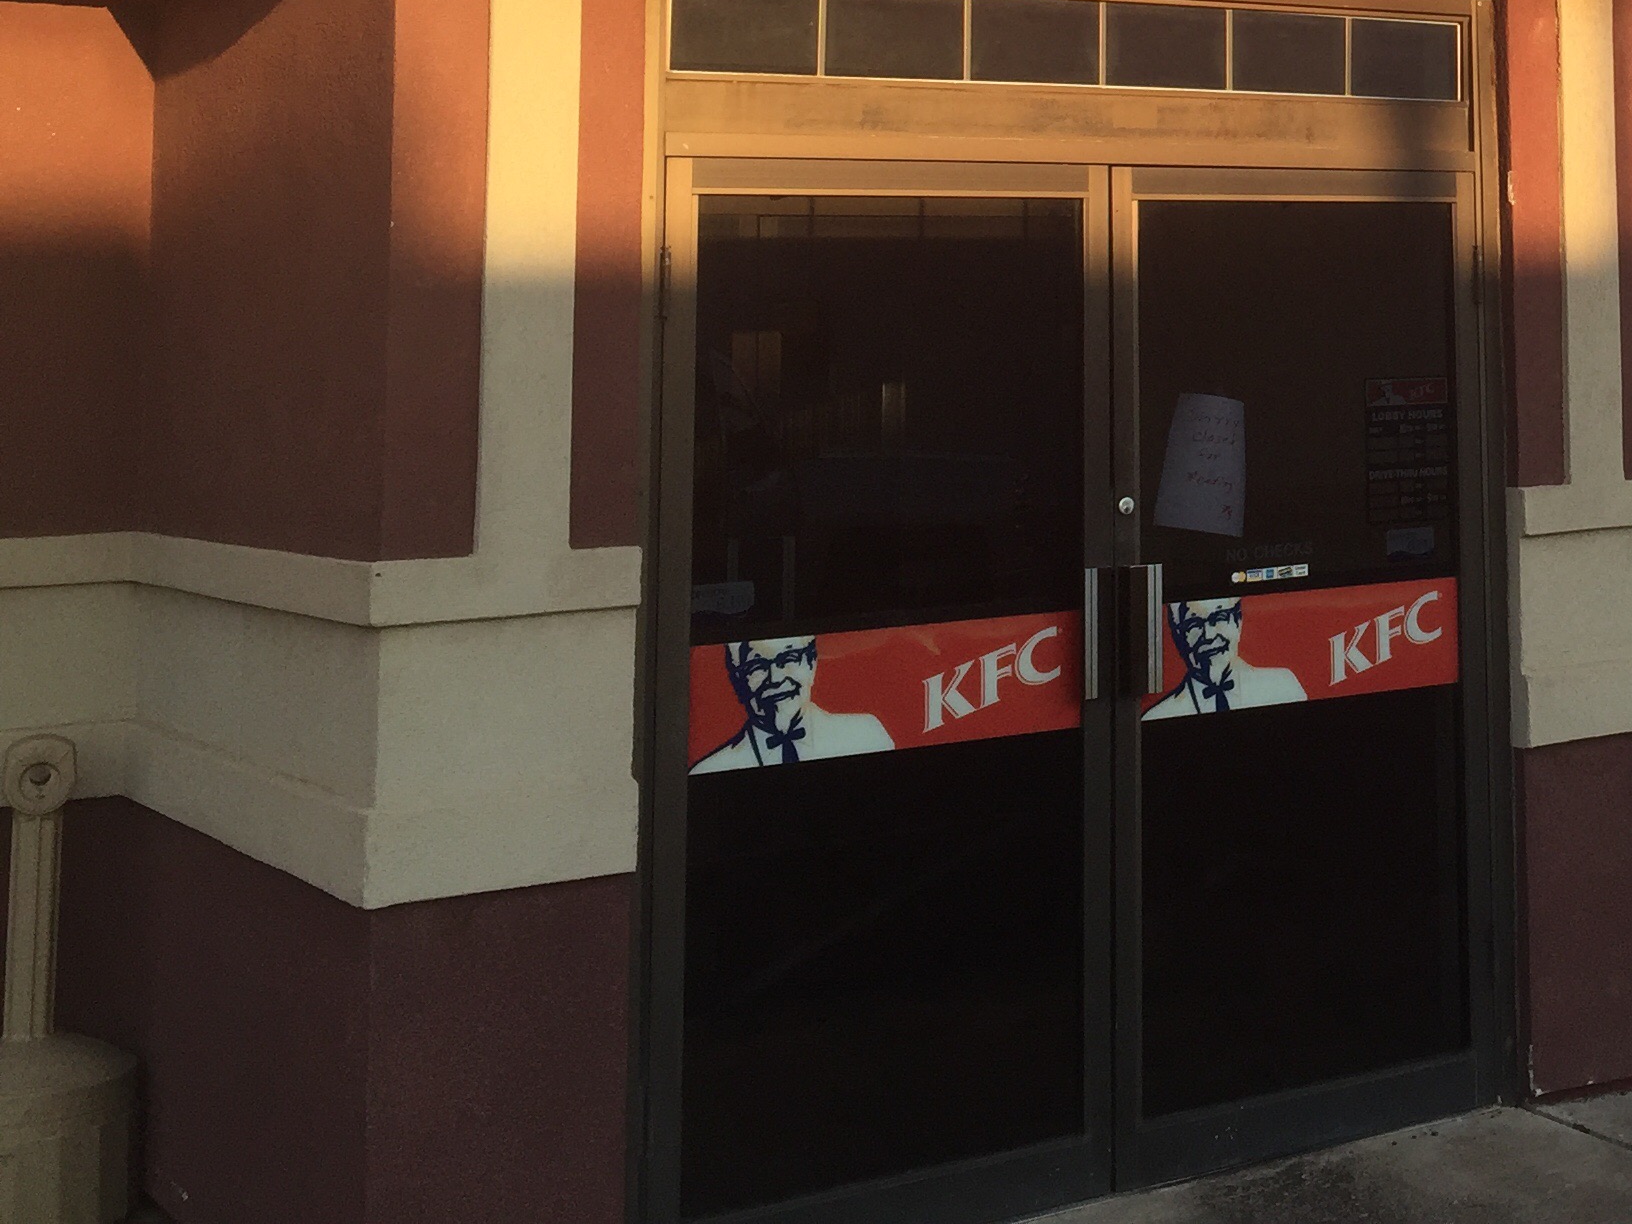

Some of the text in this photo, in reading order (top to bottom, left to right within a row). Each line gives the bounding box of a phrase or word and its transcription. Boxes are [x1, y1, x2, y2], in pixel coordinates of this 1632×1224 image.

[1371, 408, 1443, 422] LOBBY HOURS
[1419, 465, 1448, 478] HOURS
[1226, 540, 1313, 562] NO CHECKS
[1329, 590, 1443, 687] KFC
[922, 625, 1062, 735] KFC
